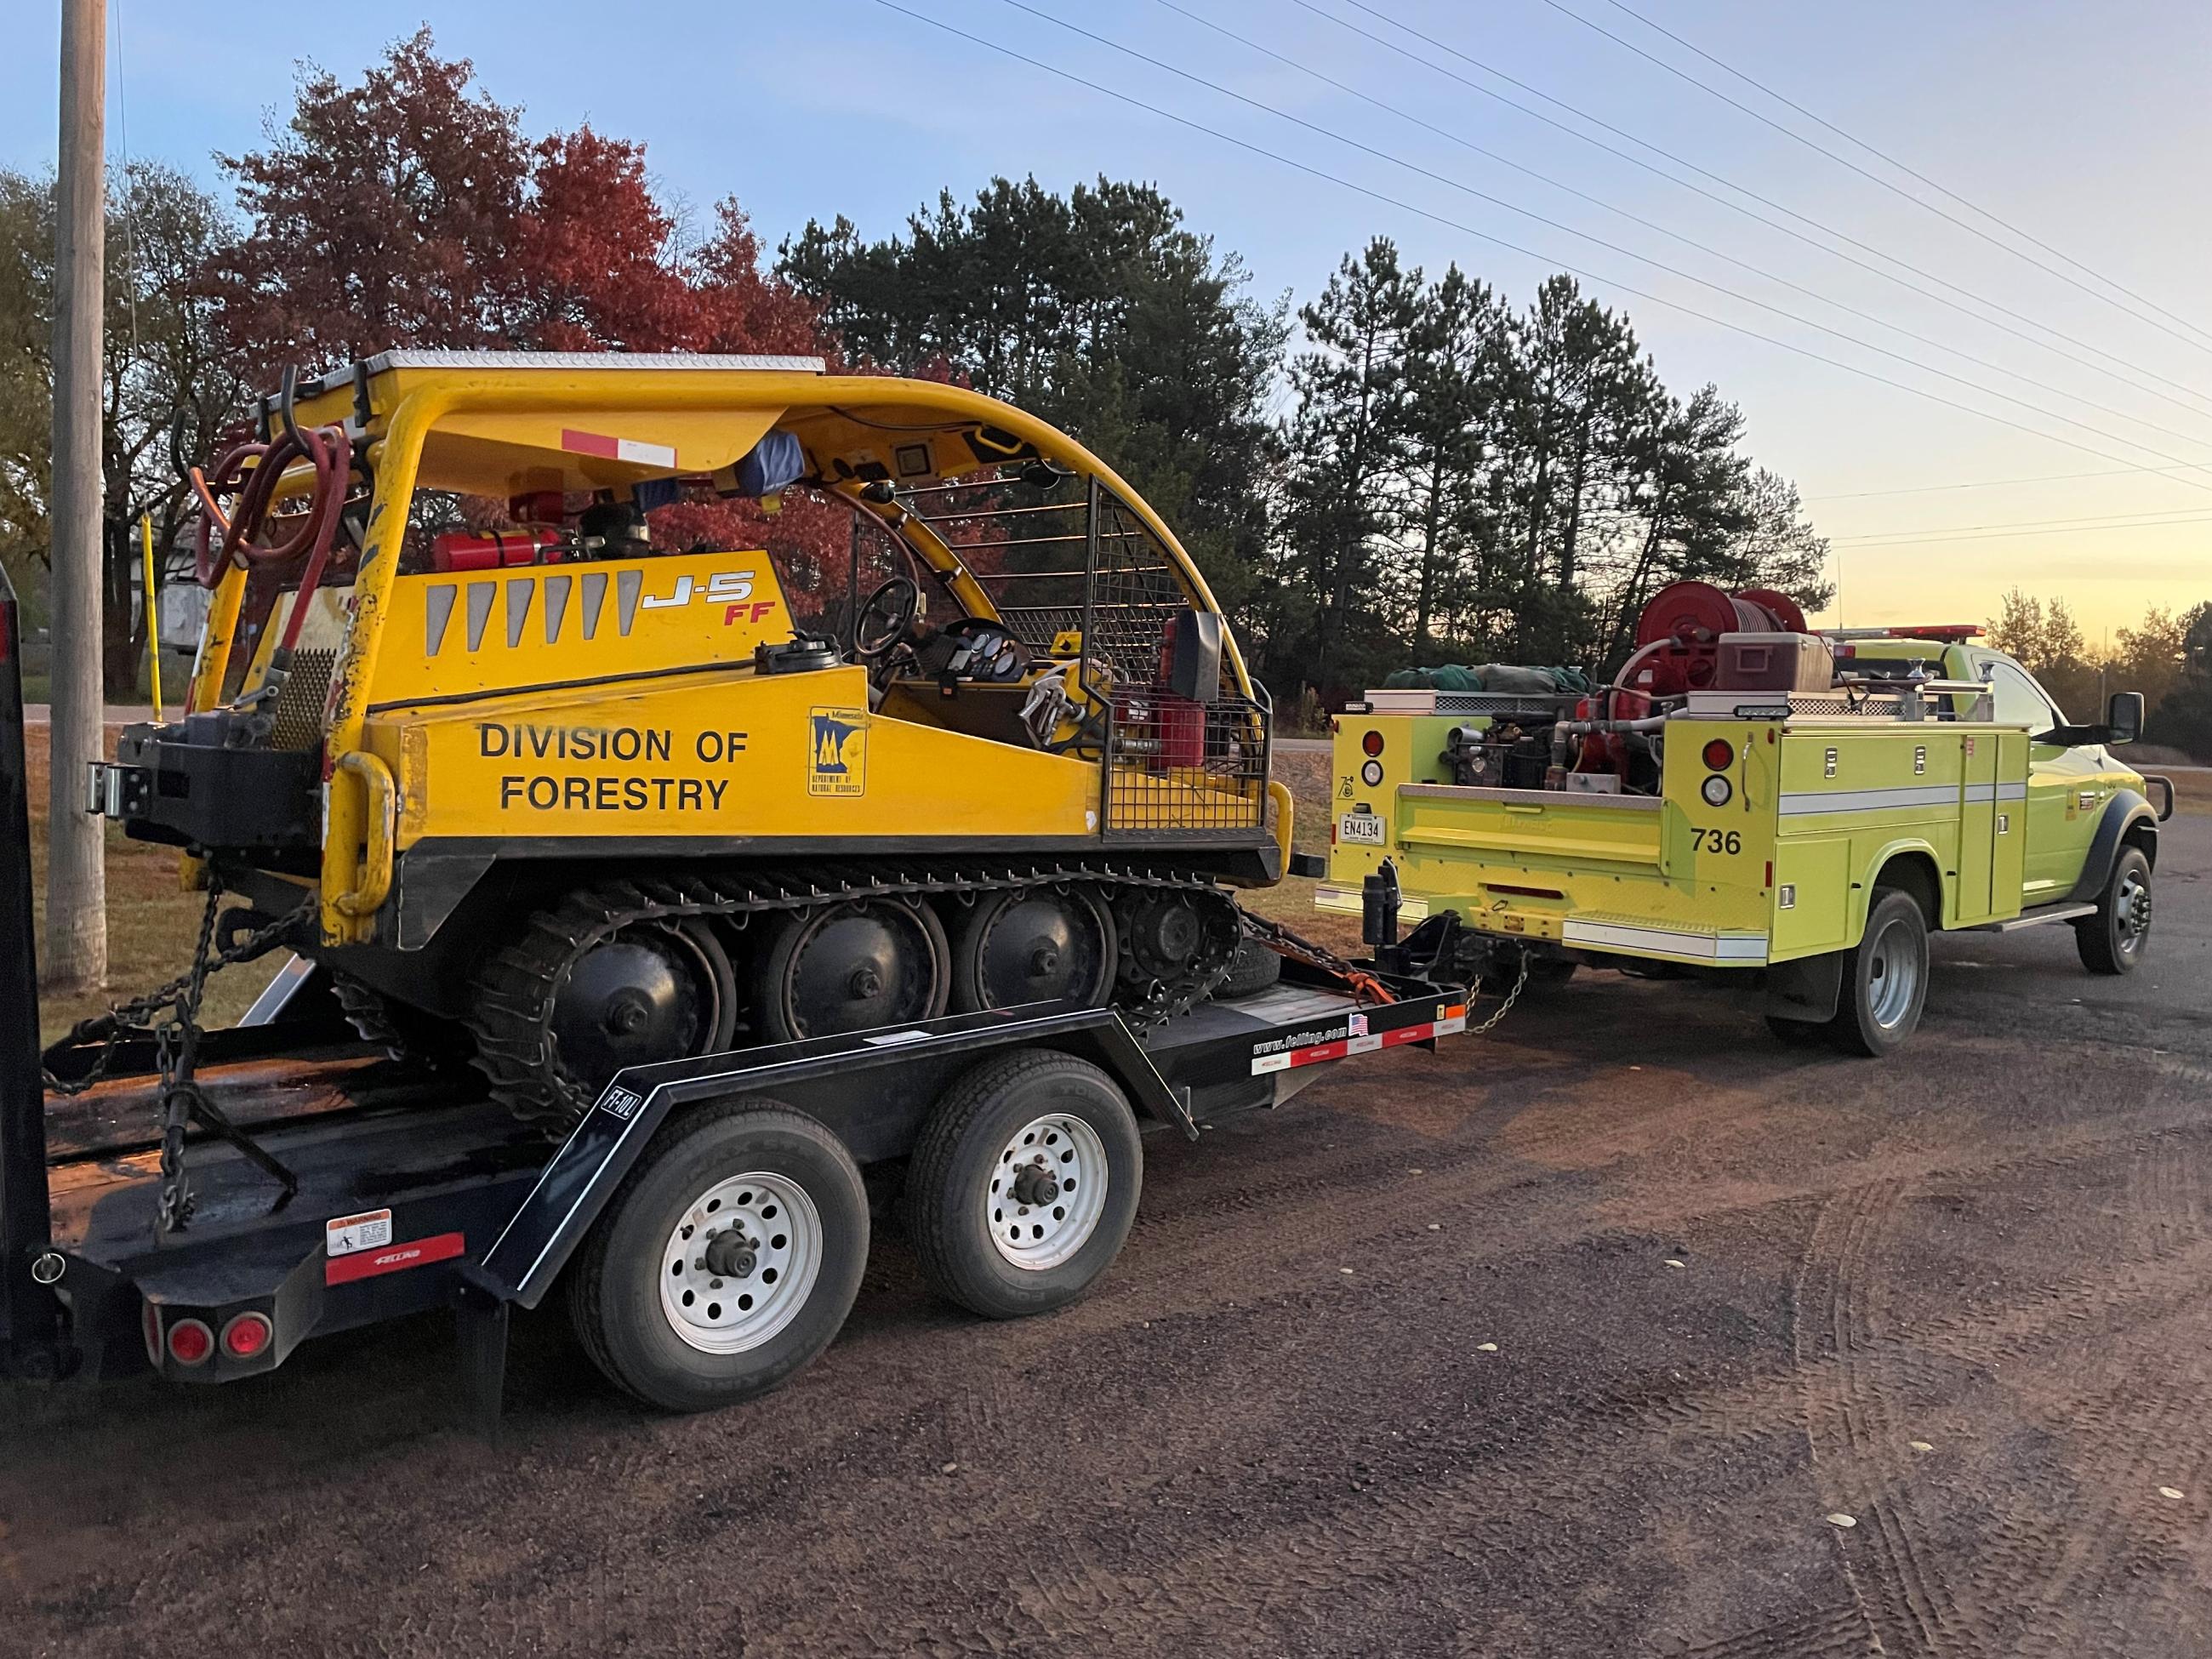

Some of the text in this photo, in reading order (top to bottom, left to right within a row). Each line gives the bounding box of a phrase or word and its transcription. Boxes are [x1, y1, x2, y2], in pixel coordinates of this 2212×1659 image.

[641, 571, 755, 608] J-5
[724, 601, 775, 626] FF
[481, 723, 748, 763] DIVISION OF
[501, 776, 729, 810] FORESTRY
[1344, 820, 1378, 837] EN4134
[1690, 828, 1741, 855] 736
[1253, 1026, 1347, 1054] www.felling.com
